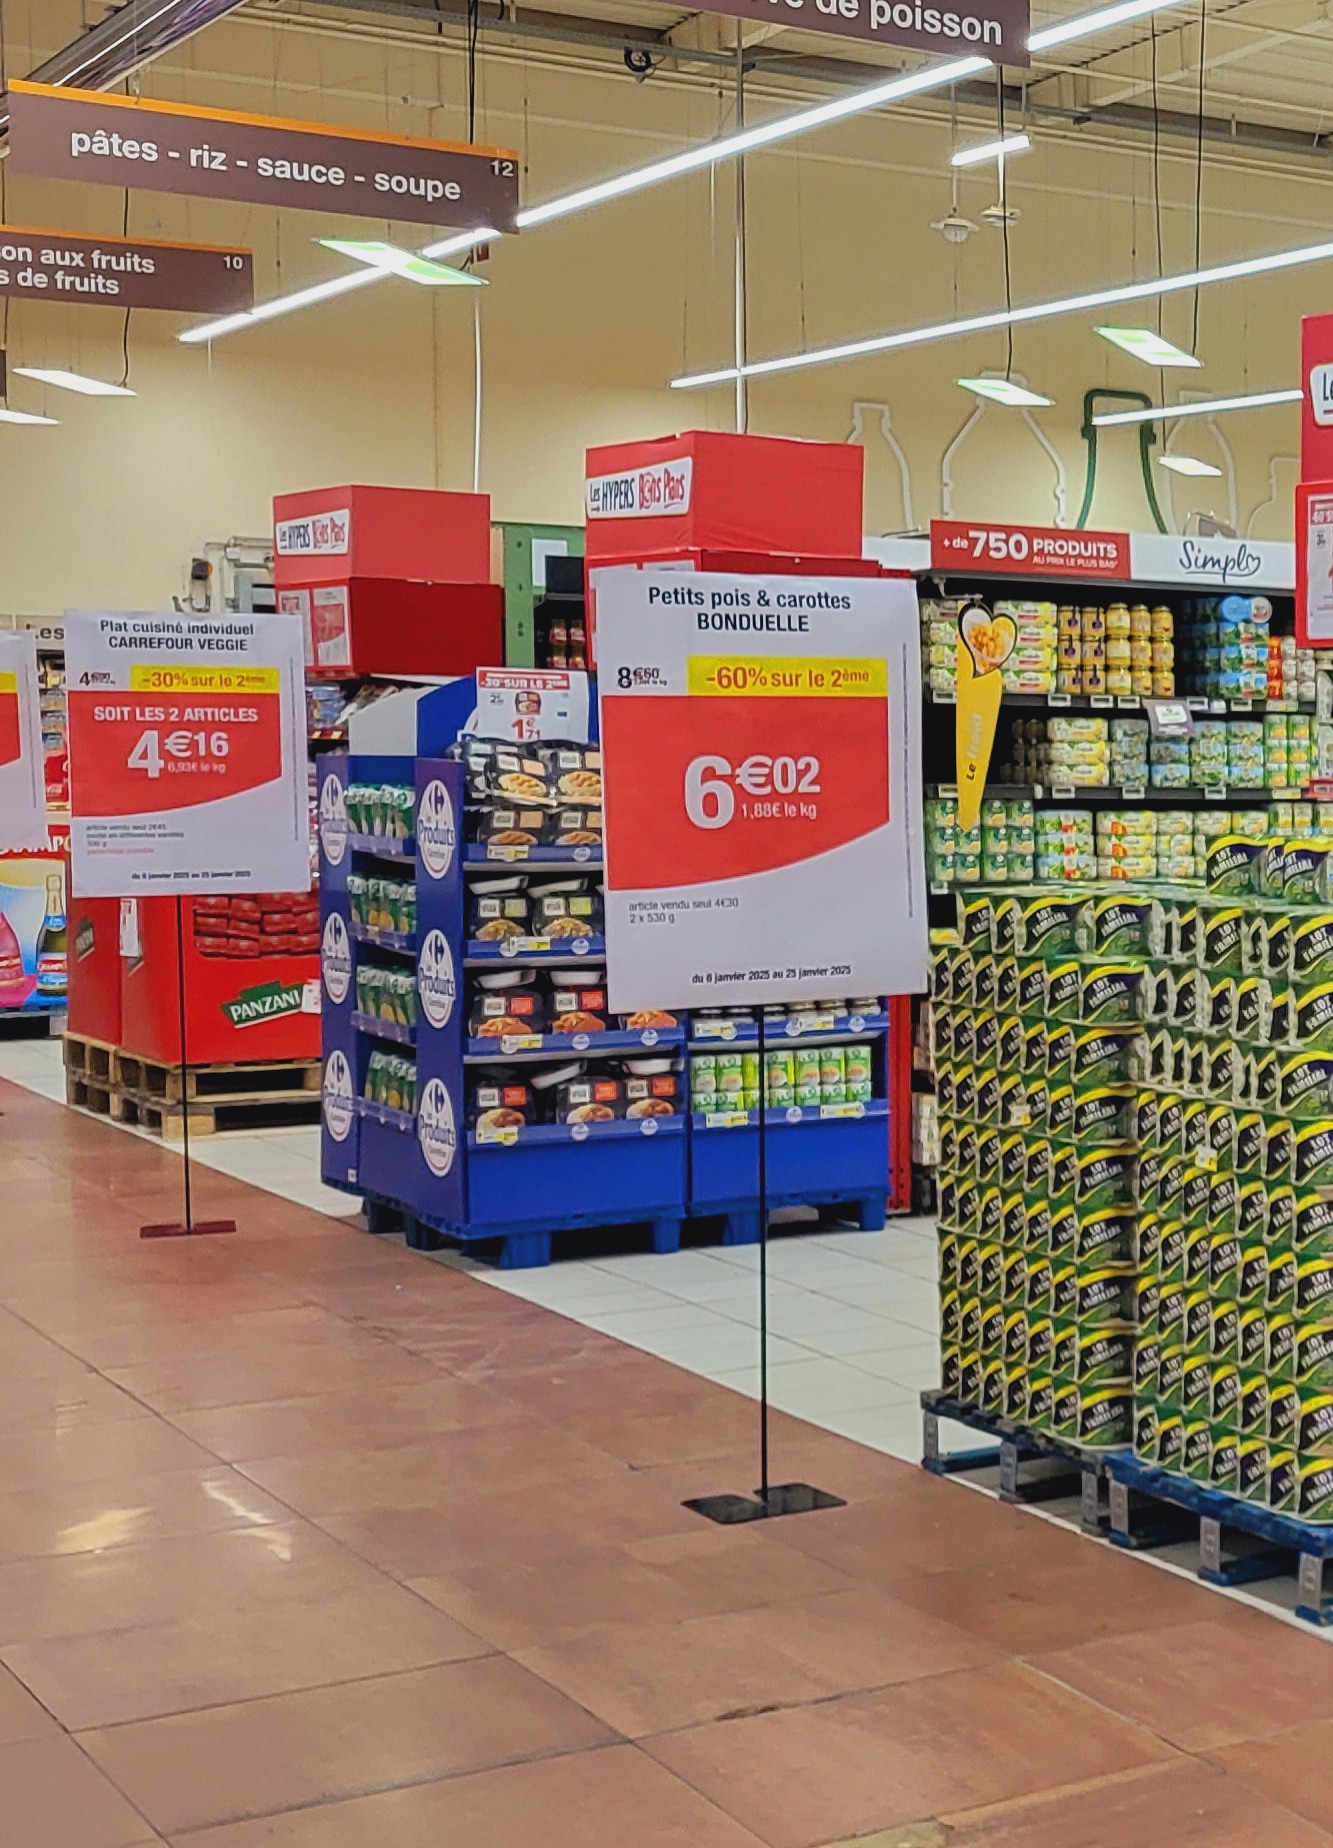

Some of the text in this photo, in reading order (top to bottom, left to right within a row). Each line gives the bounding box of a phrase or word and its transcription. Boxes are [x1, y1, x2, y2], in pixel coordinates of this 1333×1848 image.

[871, 0, 1002, 45] poisson
[70, 129, 461, 201] pâtes riz sauce soupe
[490, 160, 514, 177] 12
[40, 248, 155, 274] aux fruits
[223, 256, 243, 270] 10
[17, 267, 120, 295] de fruits
[590, 468, 685, 512] Les HYPERS Plans
[953, 529, 1117, 561] de 750 PRODUITS
[1033, 556, 1098, 568] AU PRIX LE PLUS
[649, 586, 851, 611] Petits pois & carottes
[100, 620, 254, 635] Plat cuisiné individuel
[697, 613, 809, 633] BONDUELLE
[108, 636, 248, 651] CARREFOUR VEGGIE
[142, 671, 232, 688] -30% sur le
[705, 665, 768, 690] -60%
[771, 670, 802, 688] sur
[808, 668, 824, 688] le
[94, 706, 258, 722] SOIT LES 2 ARTICLES
[741, 802, 817, 820] 1,88€ le kg
[418, 817, 454, 846] Produits
[629, 901, 658, 911] article
[661, 900, 690, 911] vendu
[692, 899, 712, 910] seul
[629, 913, 674, 924] 2 530 g
[419, 970, 455, 998] Produits
[692, 975, 703, 984] du
[714, 972, 746, 984] janvier
[748, 970, 770, 981] 2025
[773, 970, 783, 979] au
[799, 967, 828, 980] janvier
[830, 965, 851, 976] 2025
[230, 990, 300, 1022] PANZANI
[419, 1117, 455, 1146] Produits
